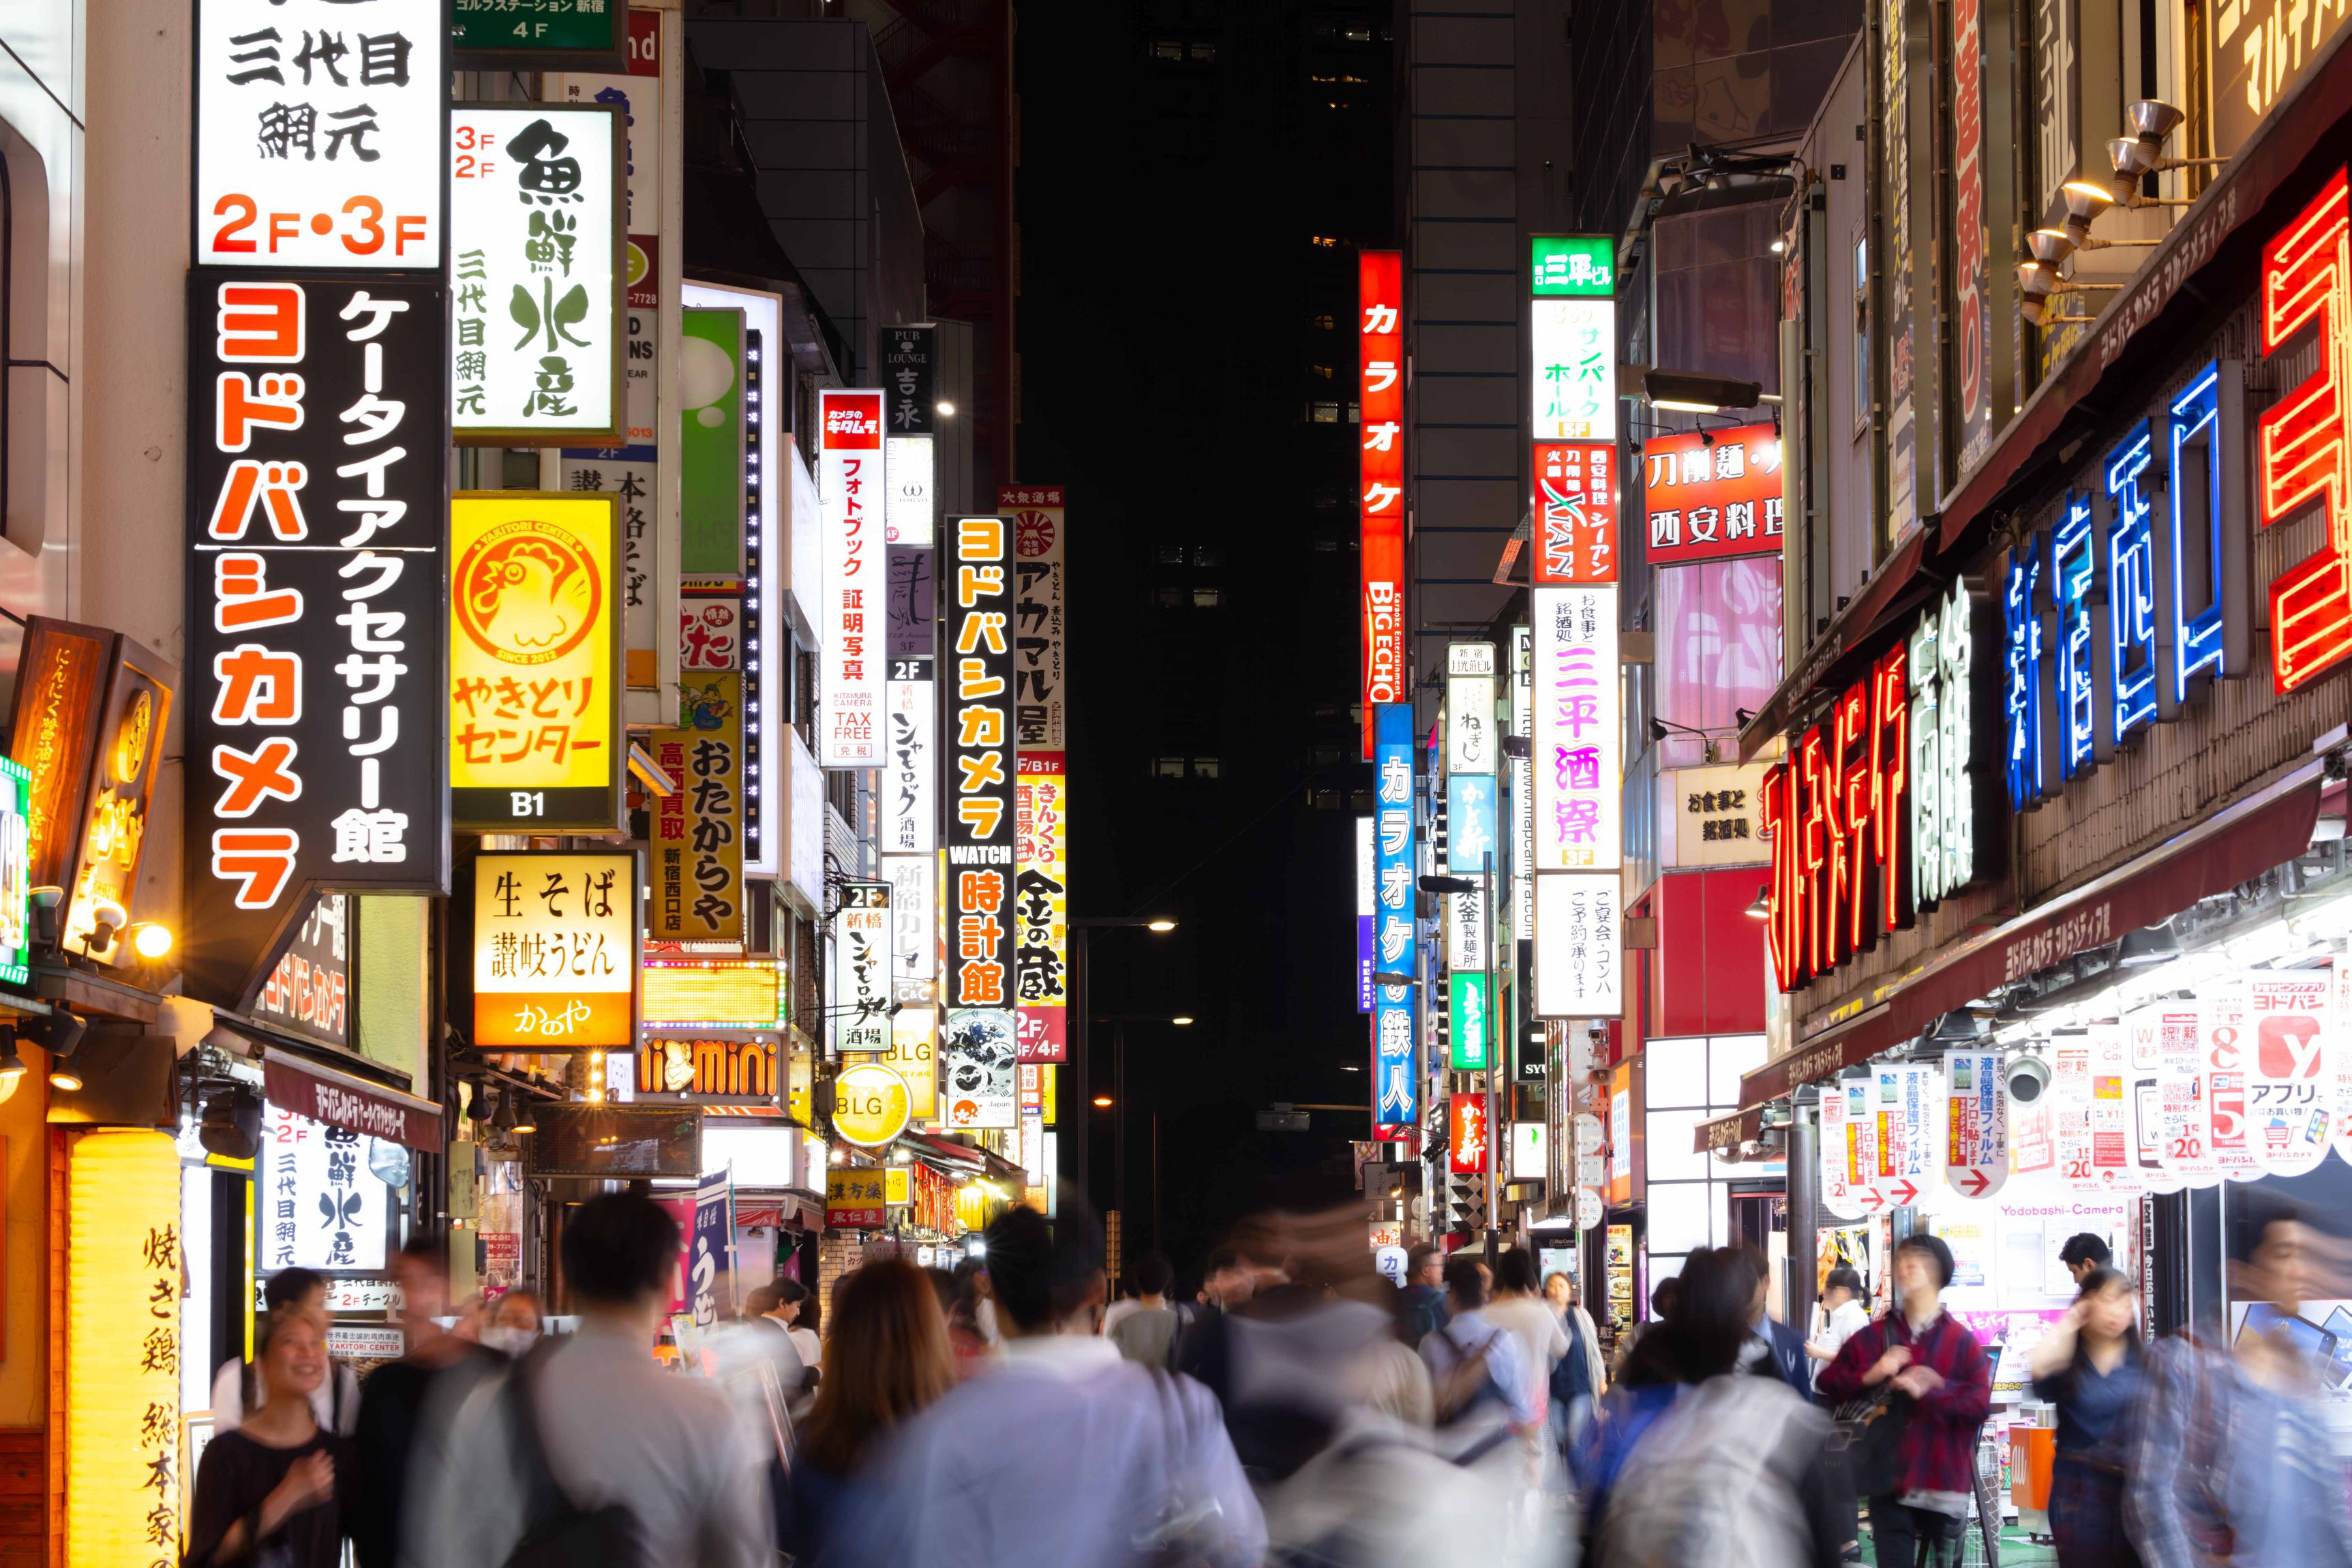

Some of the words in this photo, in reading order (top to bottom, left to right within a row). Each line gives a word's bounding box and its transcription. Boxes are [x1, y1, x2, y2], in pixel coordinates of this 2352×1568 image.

[512, 22, 548, 38] 4F
[226, 27, 413, 87] 三代目
[257, 101, 381, 162] 網元
[455, 126, 495, 150] 3F
[455, 155, 495, 179] 2F
[505, 118, 592, 417] 魚鮮水産
[456, 249, 487, 416] 三代目網元
[894, 331, 920, 340] PUB
[2100, 271, 2161, 373] ヨドバシカメラ
[888, 353, 927, 363] LOUNGE
[1578, 327, 1605, 418] サンパーク
[894, 367, 922, 429] 吉永
[1363, 303, 1401, 513] カラオケ
[1545, 363, 1571, 418] ホール
[826, 420, 878, 435] キタムラ
[828, 410, 863, 420] カメラの
[1562, 423, 1588, 437] 5F
[1590, 450, 1608, 505] 西安料理
[481, 521, 533, 545] YAKITORI
[534, 522, 576, 547] CENTER
[843, 458, 864, 577] フォトブック
[1589, 512, 1610, 576] シーアン
[208, 282, 308, 909] ヨドバシカメラ
[331, 290, 409, 863] ケータイアクセサリー館
[2004, 359, 2225, 813] 新宿西口
[1368, 582, 1393, 631] BIG
[1556, 602, 1573, 642] 銘酒処
[1580, 594, 1596, 643] お食事と
[496, 649, 528, 664] SINCE
[530, 650, 558, 663] 2012
[842, 589, 864, 680] 証明写真
[900, 642, 916, 652] 3F
[1460, 648, 1483, 659] 新宿
[894, 661, 920, 680] 2F
[956, 518, 1008, 839] ヨドバシカメラ
[1370, 635, 1394, 703] ECHO
[453, 676, 593, 720] やきとり
[834, 712, 872, 726] TAX
[455, 725, 601, 765] センター
[834, 727, 873, 739] FREE
[840, 746, 866, 755] 免税
[1460, 712, 1482, 763] ねぎし
[510, 791, 543, 816] B1
[1037, 783, 1057, 864] きんくら
[1687, 789, 1747, 814] お食事と
[691, 739, 735, 930] おたからや
[899, 817, 916, 849] 酒場
[1702, 817, 1750, 842] 銘酒処
[950, 845, 1011, 864] WATCH
[1565, 849, 1592, 865] 3F
[493, 868, 615, 918] 生そば
[663, 847, 682, 931] 新宿西口店
[851, 888, 878, 907] 2F
[846, 913, 883, 929] 新橋
[959, 869, 1004, 1005] 時計館
[1379, 755, 1414, 1113] カラオケの鉄人
[1571, 890, 1588, 999] ご予約承ります
[491, 931, 614, 978] 讃岐うどん
[2005, 927, 2053, 982] ヨドバシカメラ
[514, 999, 591, 1036] かのや
[2253, 995, 2325, 1010] ヨドバシ
[845, 1028, 882, 1045] 酒場
[886, 1043, 931, 1061] BLG
[836, 1097, 882, 1115] BLG
[1905, 1071, 1921, 1175] 液晶保護フィルム
[1980, 1057, 1994, 1166] 液晶保護フィルム
[275, 1125, 308, 1144] 2F
[1863, 1121, 1875, 1184] プロが貼ります
[1895, 1110, 1907, 1176] プロが貼ります
[1967, 1096, 1980, 1166] プロが貼ります
[275, 1152, 297, 1266] 三代目網元
[828, 1181, 883, 1201] 漢方薬
[2001, 1203, 2124, 1218] Yodobashi-Camera
[832, 1211, 877, 1223] 永仁堂
[142, 1223, 177, 1377] 焼き鶏
[140, 1402, 176, 1548] 総本家
